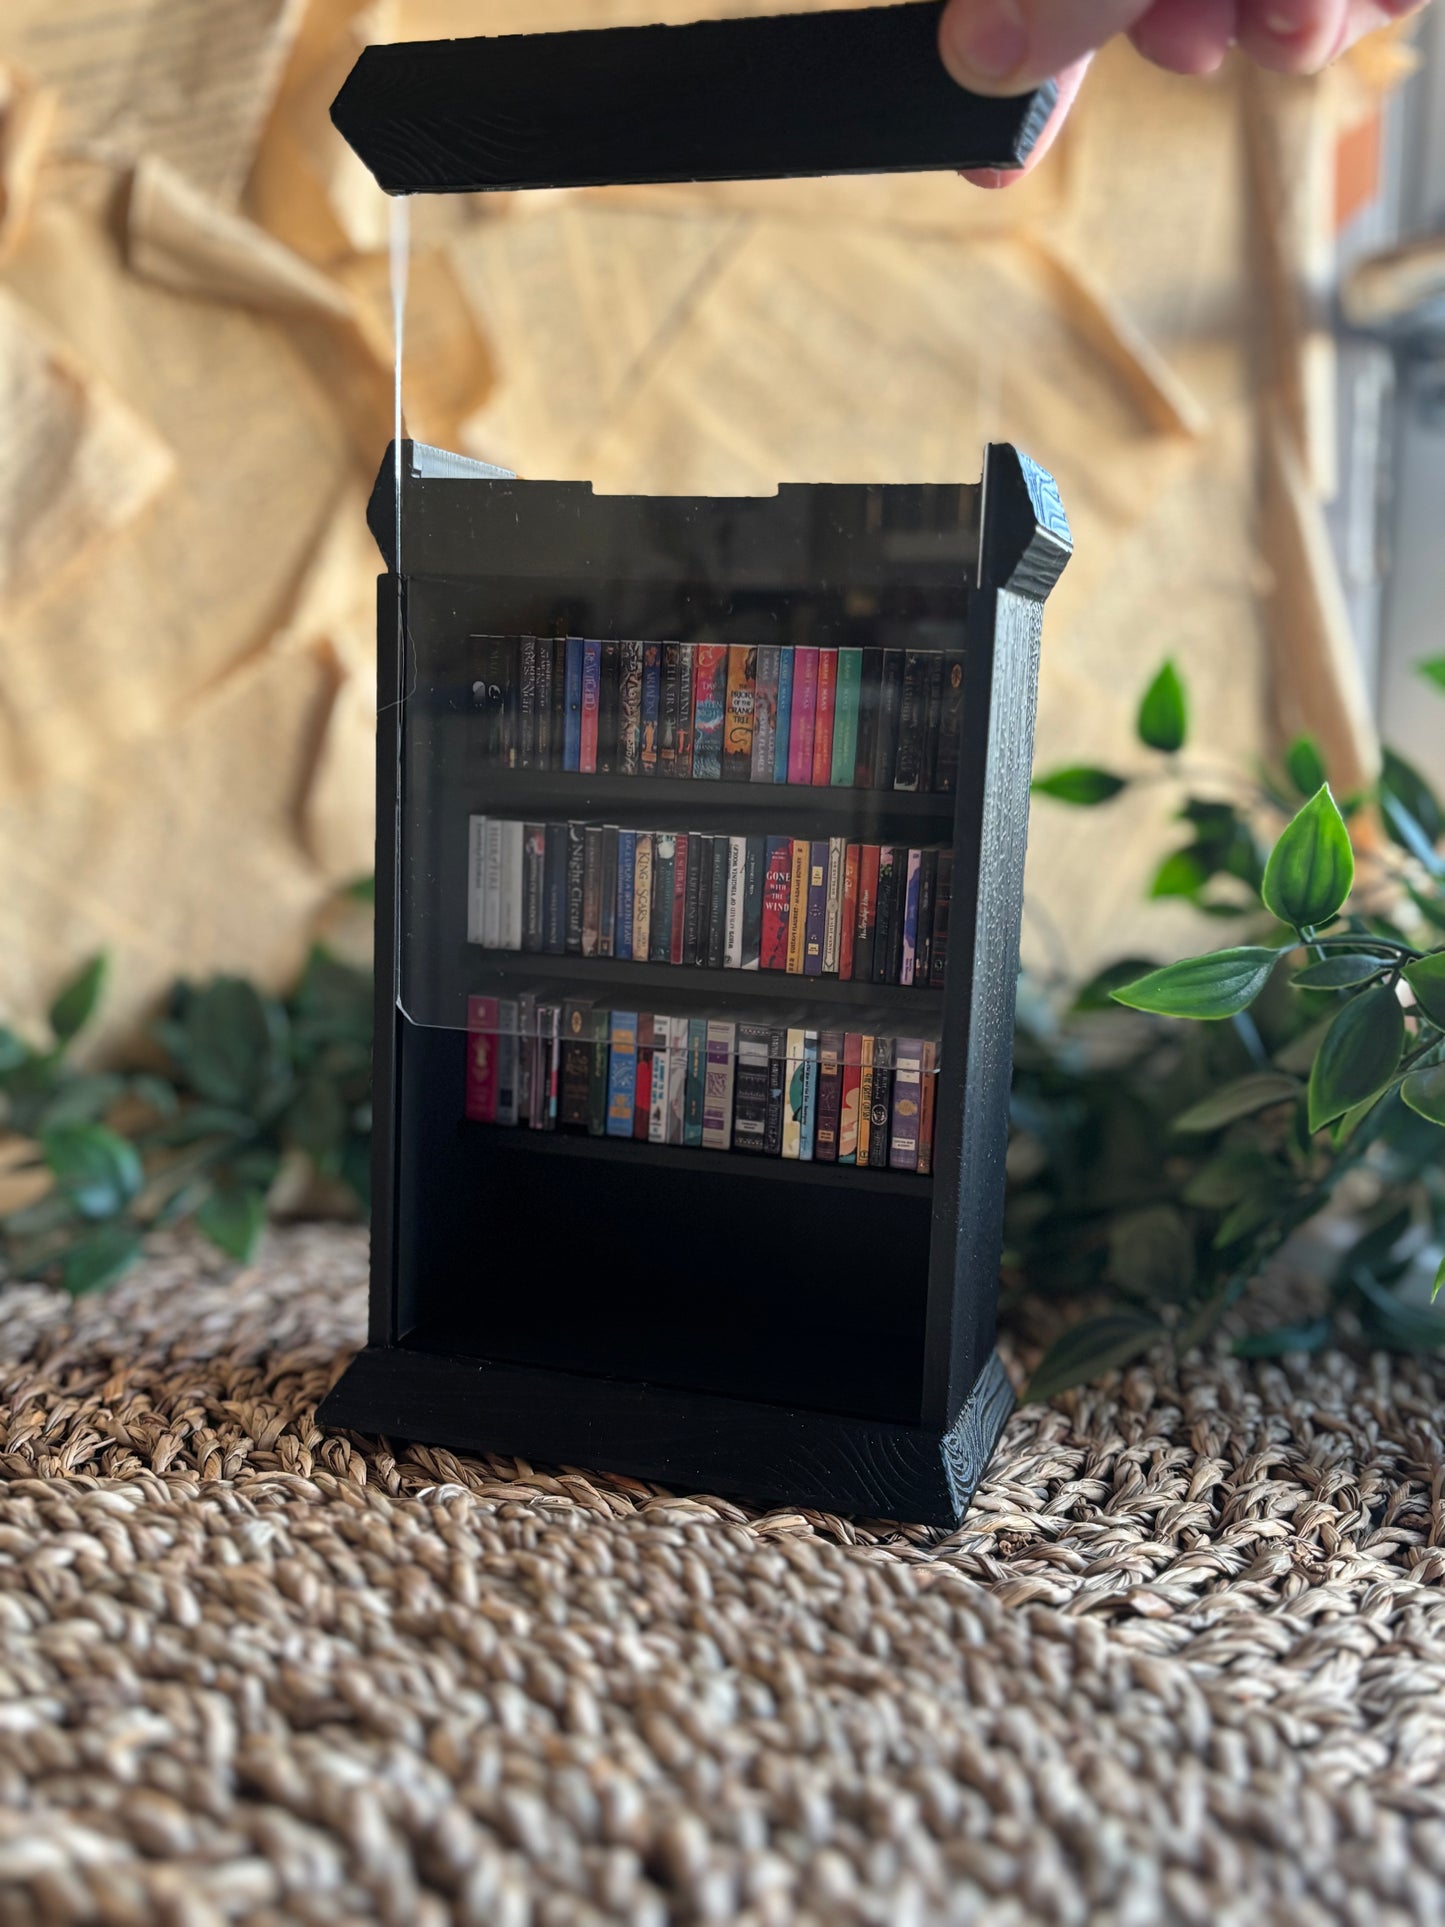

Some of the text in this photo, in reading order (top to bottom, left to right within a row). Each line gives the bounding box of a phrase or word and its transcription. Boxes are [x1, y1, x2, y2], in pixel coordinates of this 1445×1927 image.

[821, 688, 829, 711] MAAS
[733, 716, 749, 724] TREE
[624, 858, 632, 881] UPON
[638, 851, 650, 880] KING
[766, 871, 791, 882] GONE
[569, 844, 583, 932] Night Circus
[730, 868, 738, 897] VIRGINIA
[636, 888, 649, 922] SCARS
[730, 898, 737, 906] OF
[765, 902, 790, 912] WIND
[729, 907, 737, 929] AFRAID
[863, 1084, 872, 1101] GREAT
[862, 1101, 871, 1121] GATSBY
